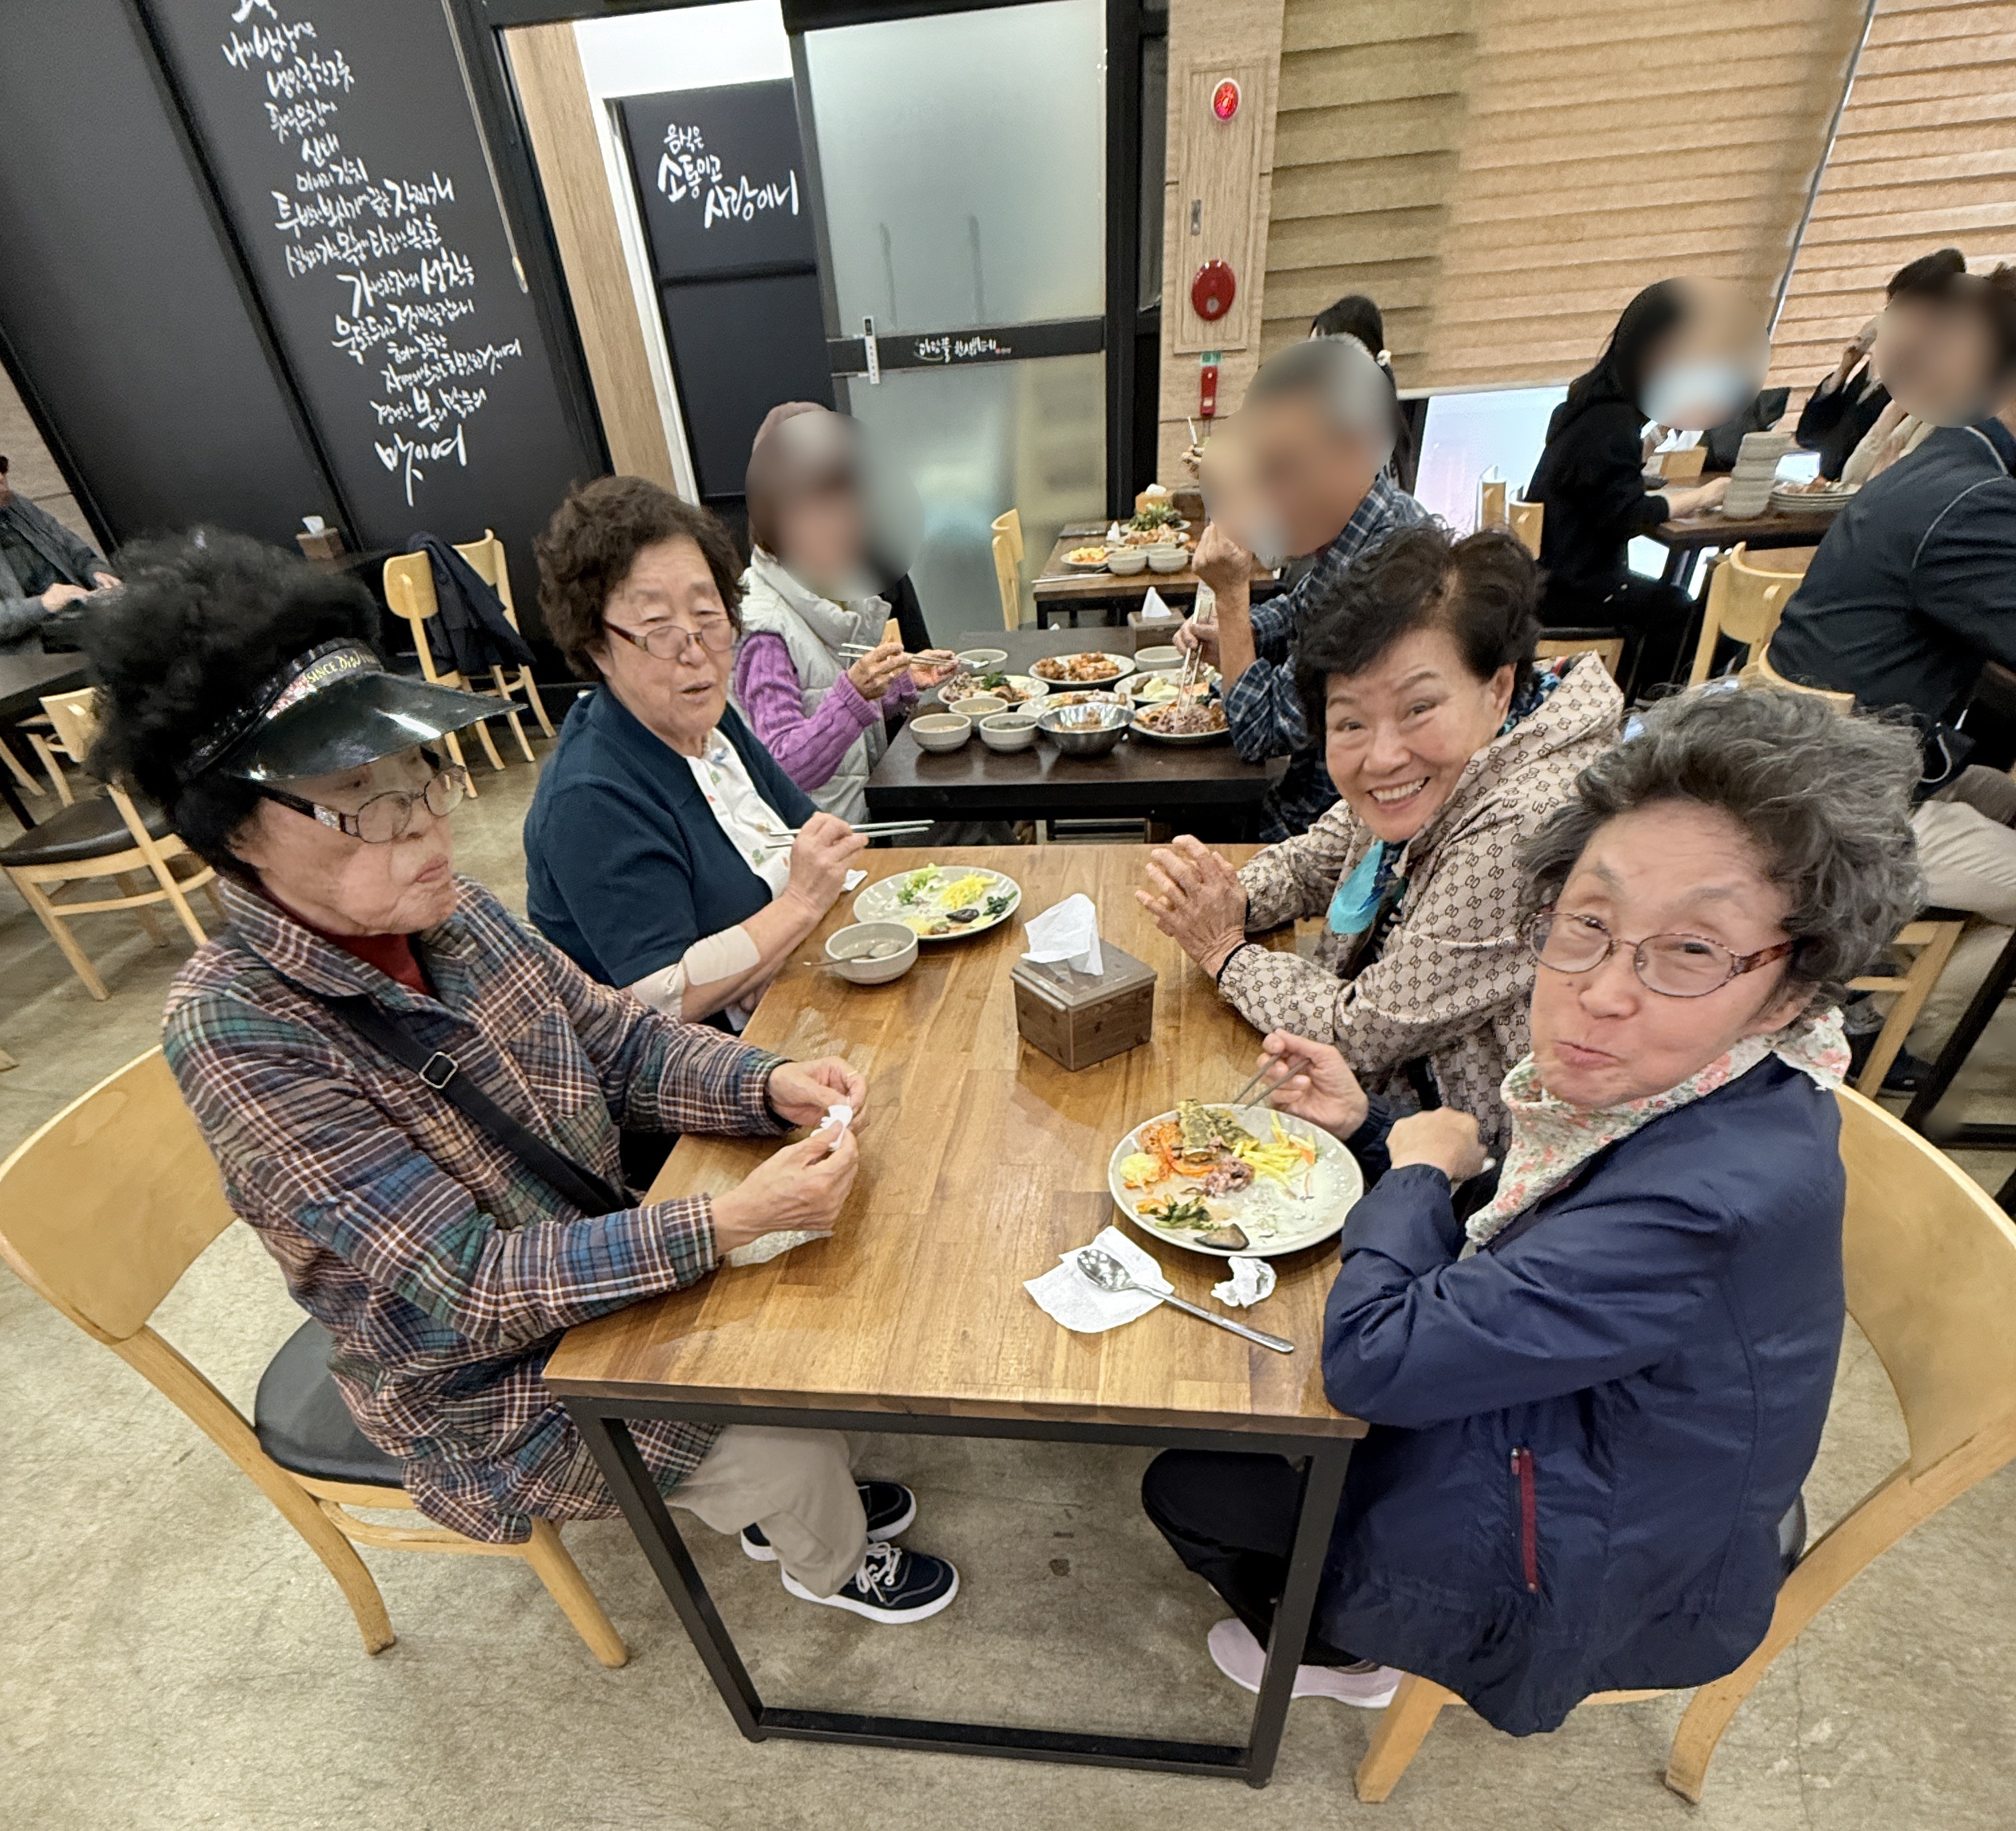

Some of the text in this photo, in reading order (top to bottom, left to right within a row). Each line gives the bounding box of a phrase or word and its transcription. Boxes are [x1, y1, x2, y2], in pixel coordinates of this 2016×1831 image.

[663, 123, 705, 155] 음식은
[657, 151, 723, 203] 소통이고
[704, 169, 799, 229] 사랑이니
